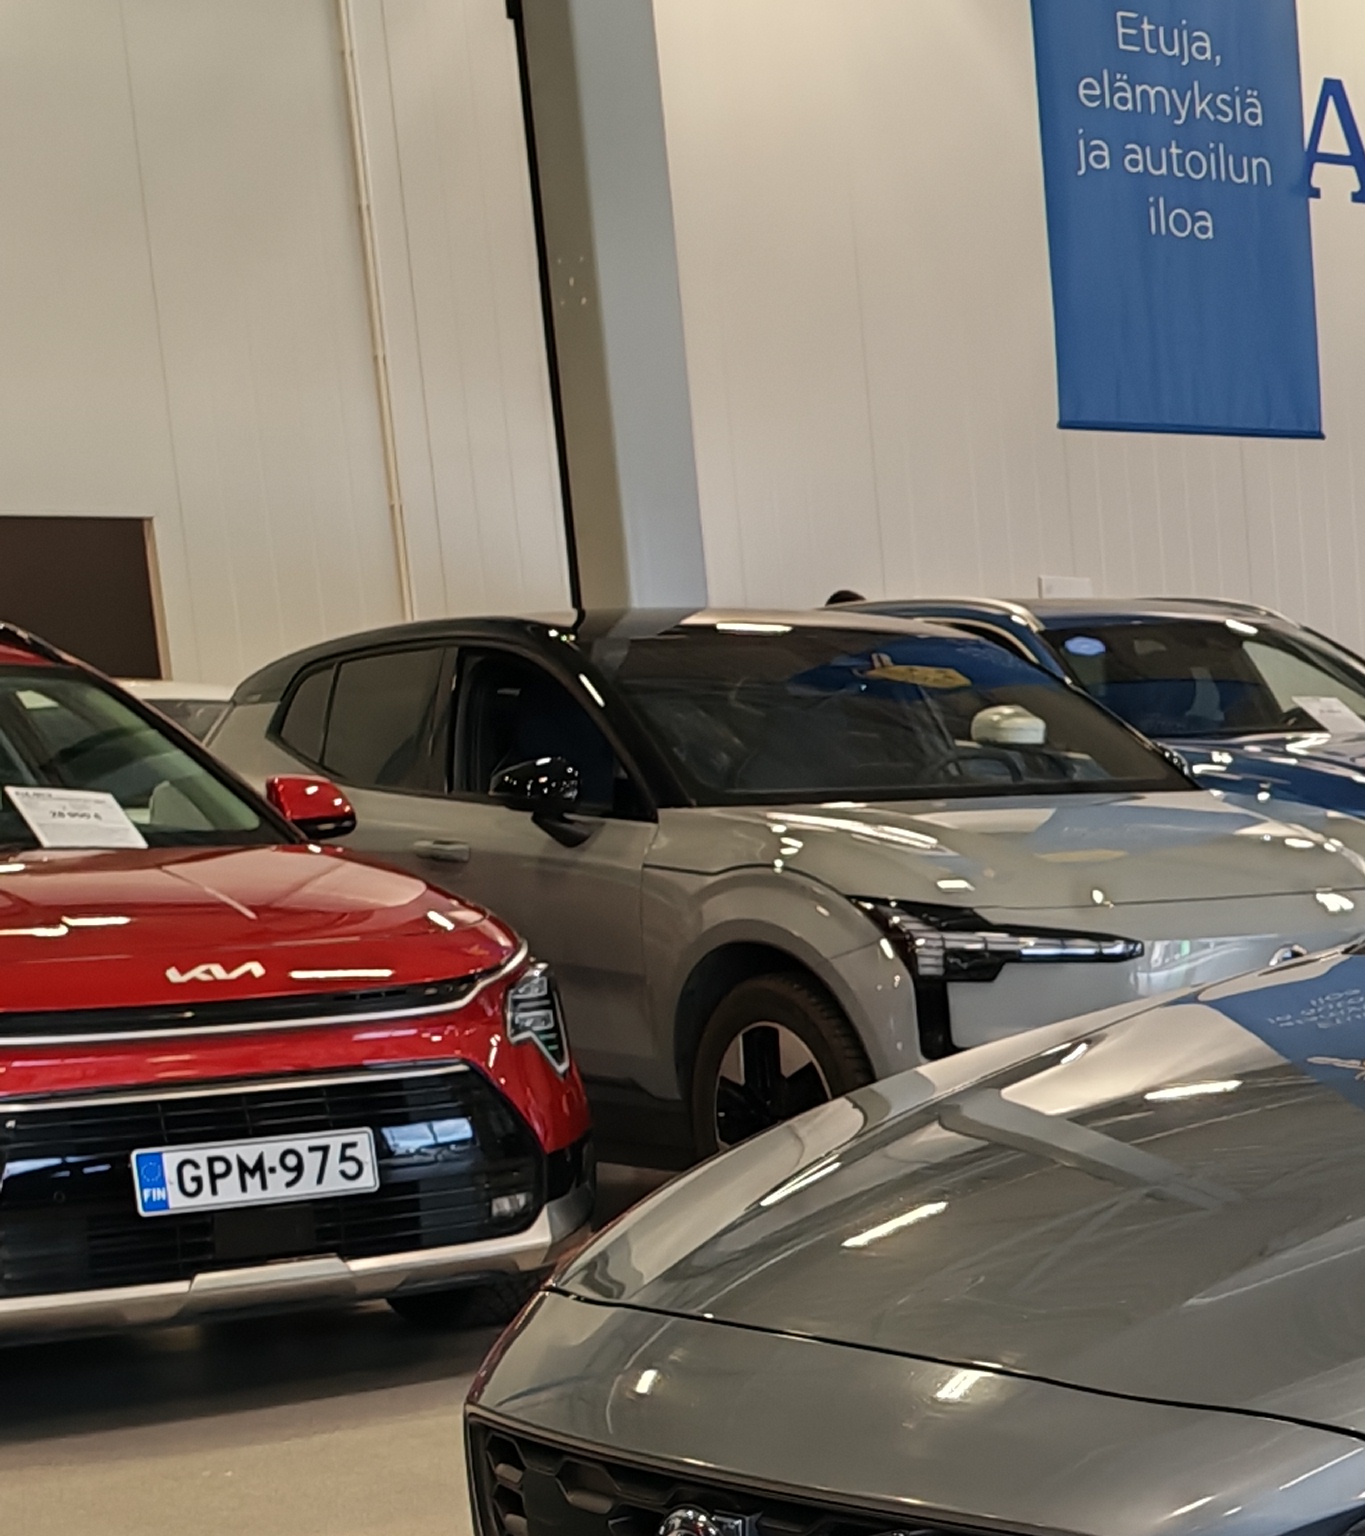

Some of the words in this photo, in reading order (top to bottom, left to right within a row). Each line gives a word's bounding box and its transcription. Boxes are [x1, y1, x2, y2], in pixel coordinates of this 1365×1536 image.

[1116, 11, 1221, 66] Etuja,
[1078, 69, 1263, 127] elämyksiä
[1077, 128, 1110, 176] ja
[1124, 140, 1272, 187] autoilun
[1149, 197, 1214, 239] iloa
[143, 1187, 168, 1203] FIN
[176, 1141, 364, 1198] GPM-975
